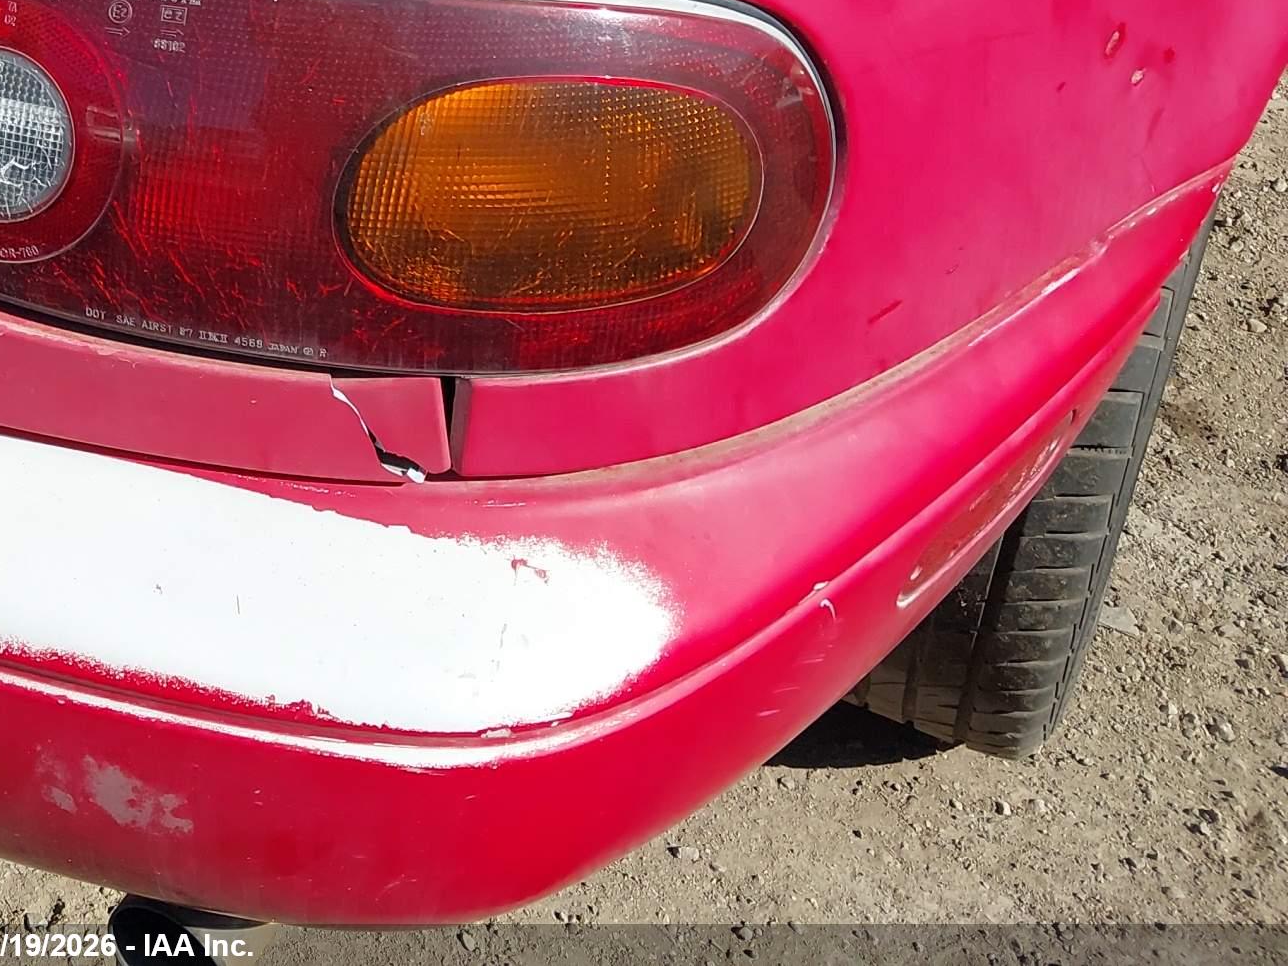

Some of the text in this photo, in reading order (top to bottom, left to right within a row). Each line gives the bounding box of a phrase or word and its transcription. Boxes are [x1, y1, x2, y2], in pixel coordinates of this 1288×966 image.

[85, 305, 107, 320] DOT
[115, 314, 136, 327] SAE
[268, 343, 298, 354] JAPAN
